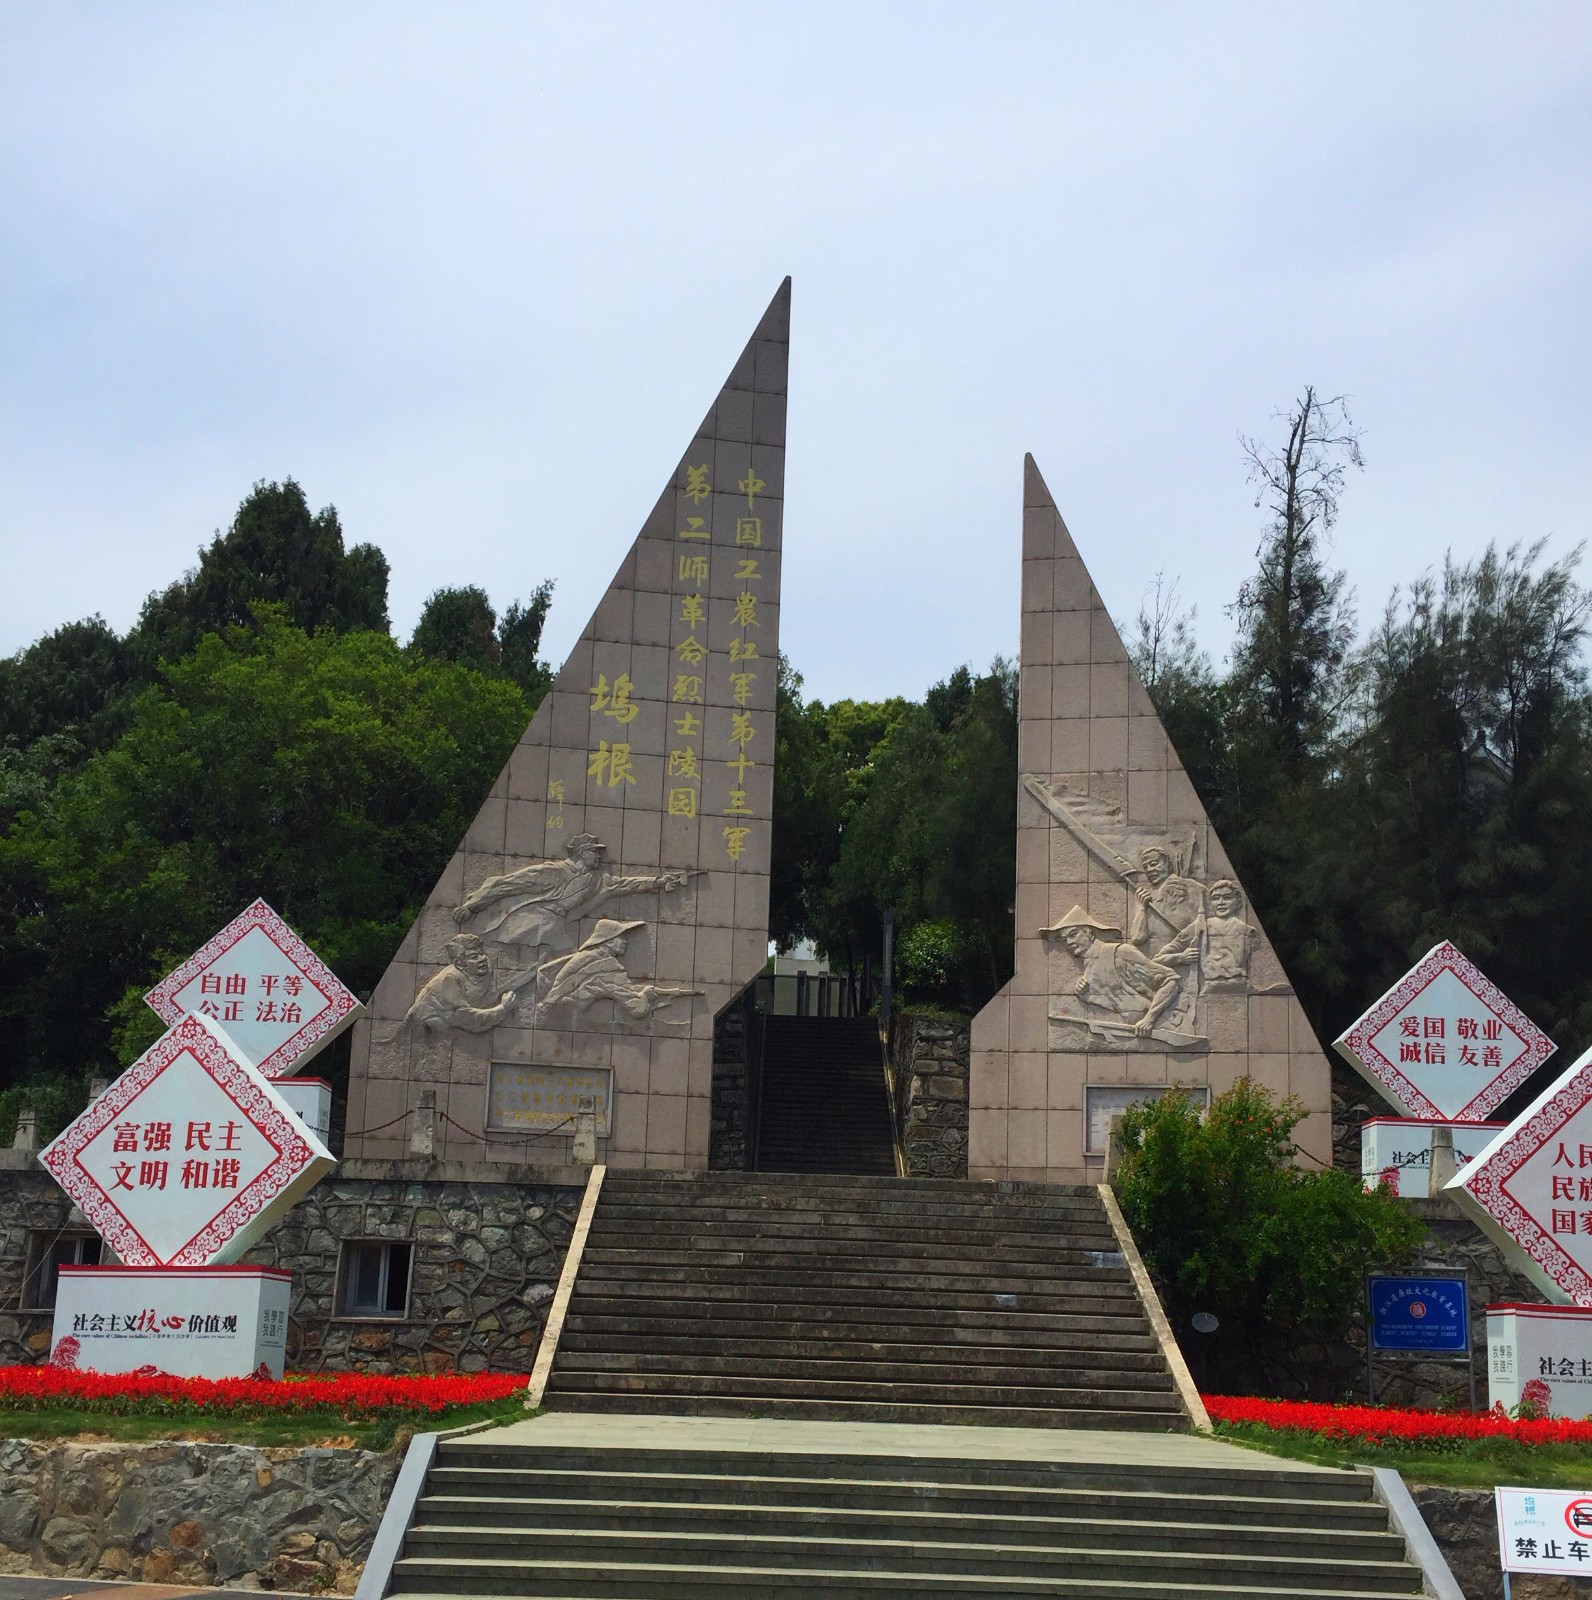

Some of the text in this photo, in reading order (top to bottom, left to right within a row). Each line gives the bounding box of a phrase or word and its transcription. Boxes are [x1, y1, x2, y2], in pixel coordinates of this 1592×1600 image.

[200, 972, 305, 996] 自由 平等
[198, 1000, 302, 1023] 公正 法治
[1398, 1015, 1503, 1041] 爱国 敬业
[1399, 1041, 1503, 1068] 诚信 友善
[113, 1120, 244, 1153] 富强 民主
[107, 1158, 241, 1192] 文明 和谐
[72, 1308, 238, 1333] 社会主义核心价值观
[1514, 1537, 1590, 1561] 禁止车
